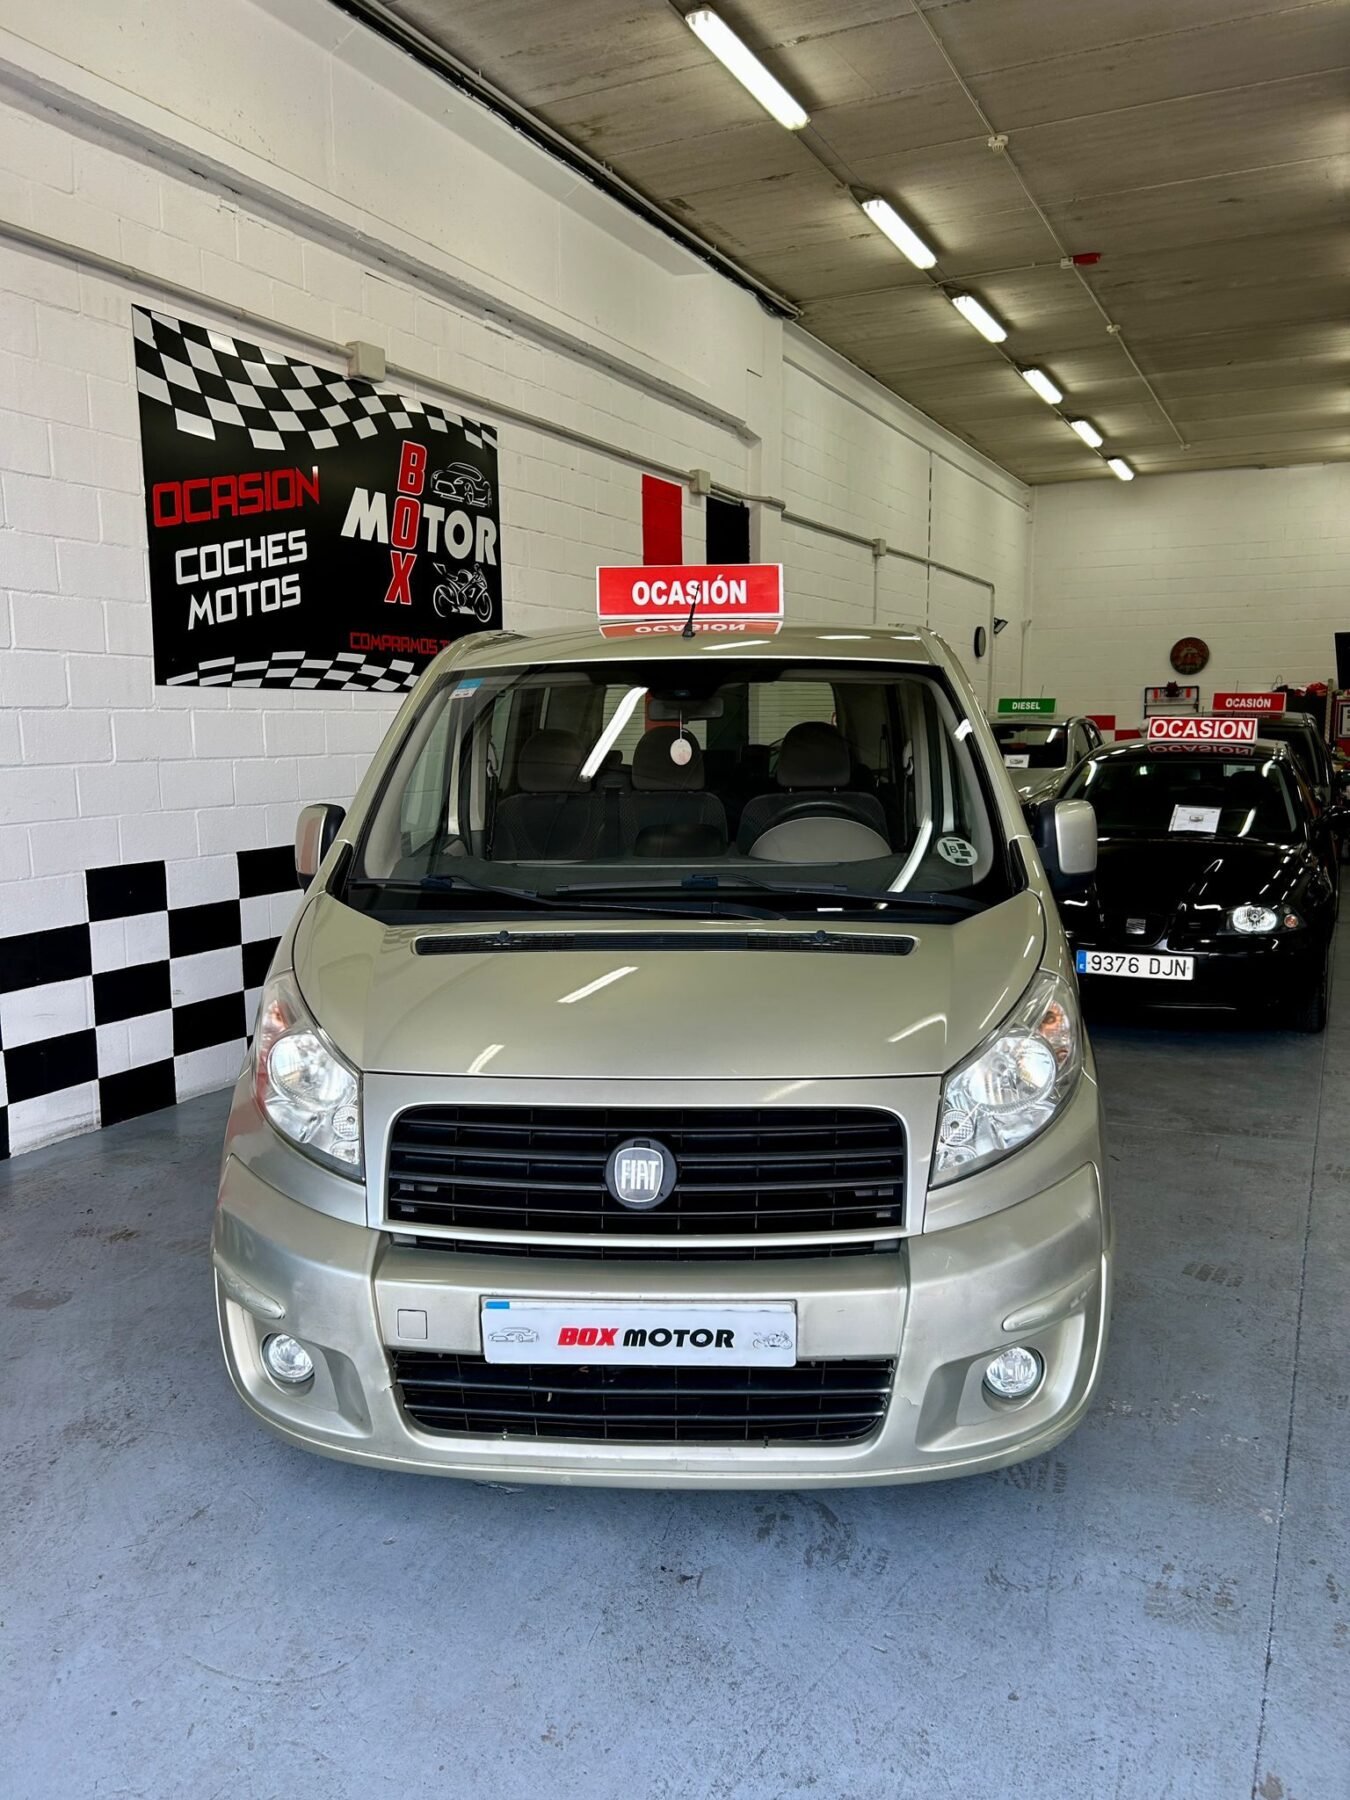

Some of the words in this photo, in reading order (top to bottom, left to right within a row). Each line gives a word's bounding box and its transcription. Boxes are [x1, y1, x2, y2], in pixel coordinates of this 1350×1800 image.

[152, 465, 320, 528] OCASION
[340, 487, 498, 566] MOTOR
[384, 440, 427, 605] BOX
[175, 529, 308, 585] COCHES
[188, 573, 302, 630] MOTOS
[632, 574, 747, 606] OCASIÓN
[350, 631, 438, 655] COMPRAMOS
[1011, 701, 1041, 710] DIESEL
[1225, 696, 1271, 708] OCASIÓN
[1151, 720, 1253, 739] OCASION
[1091, 954, 1139, 974] 9376
[1149, 957, 1187, 977] DJN
[620, 1159, 659, 1191] FIAT
[557, 1327, 619, 1347] BOX
[622, 1328, 734, 1348] MOTOR
